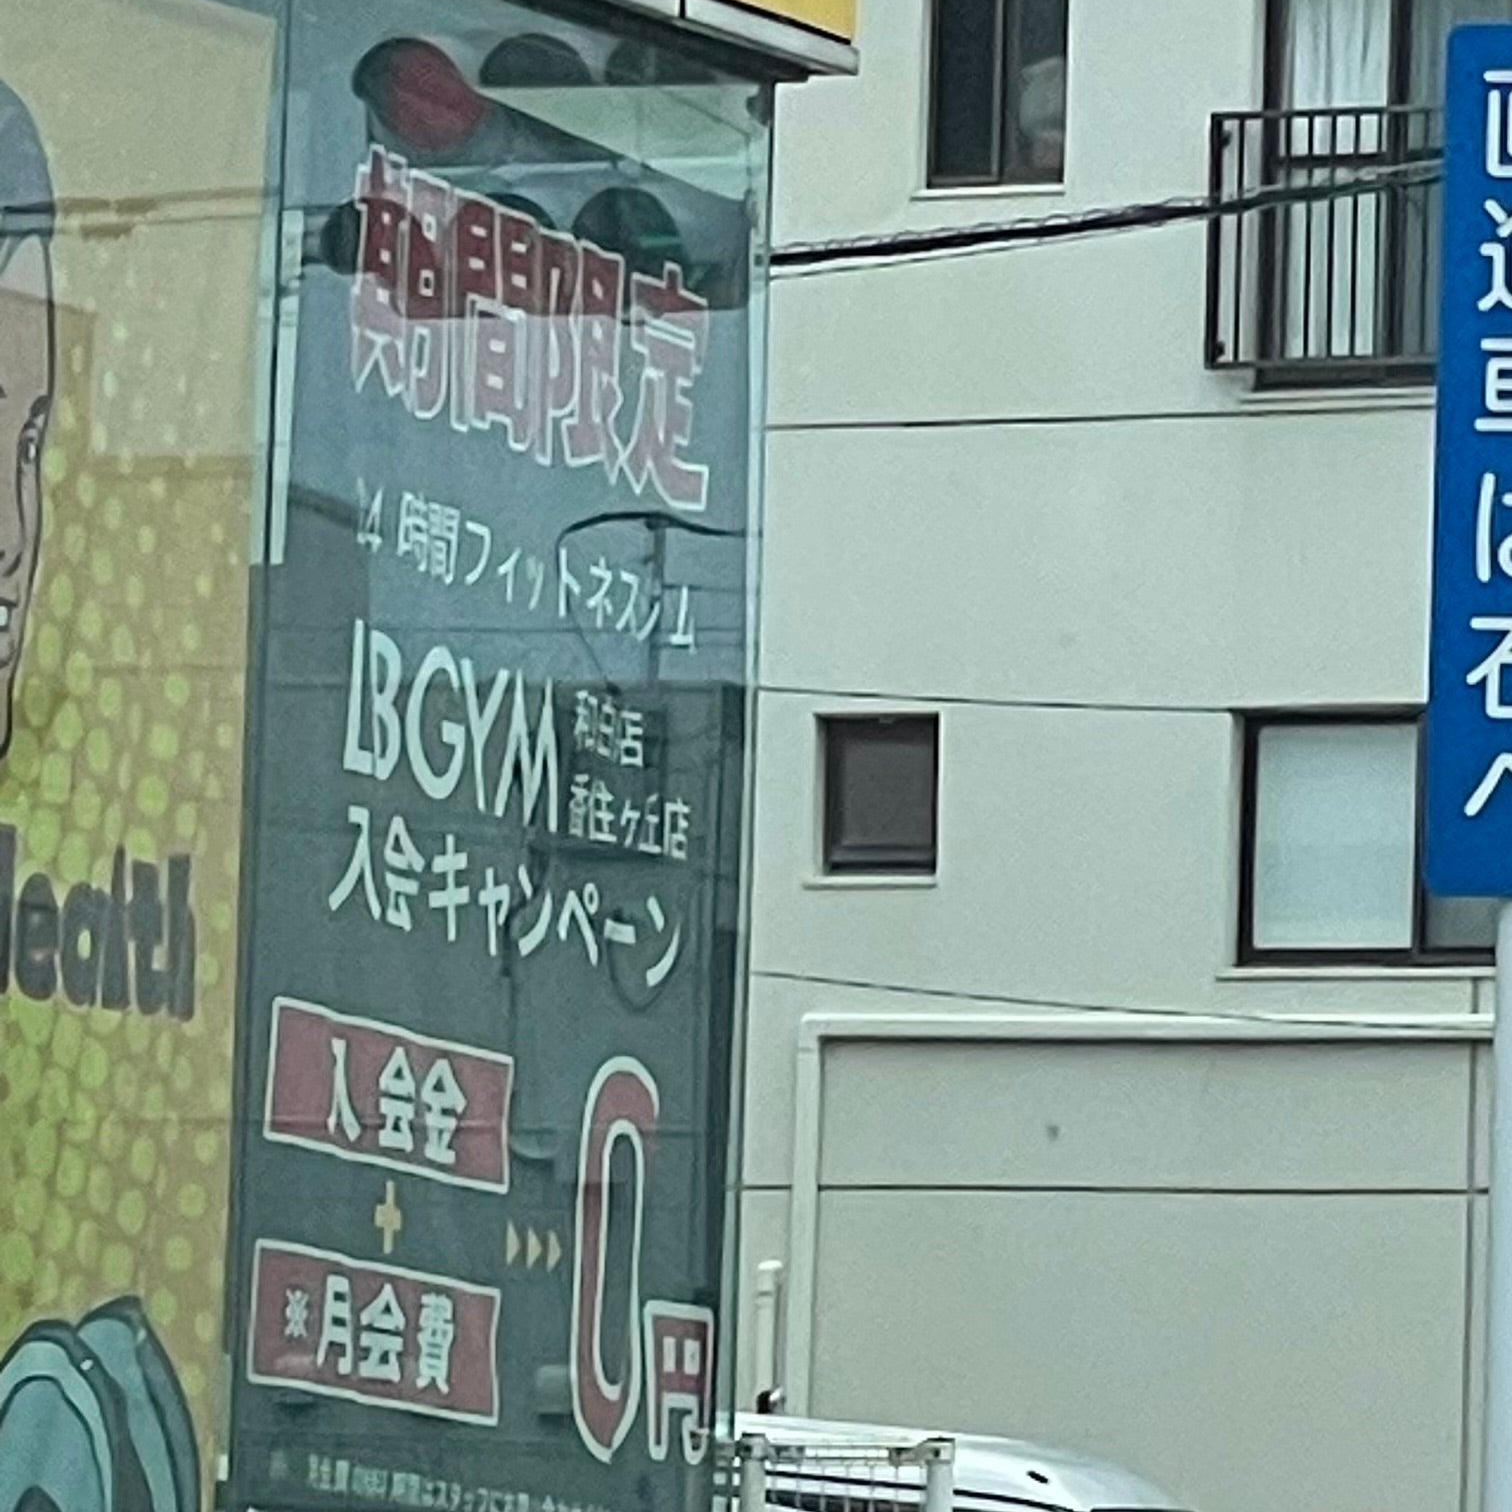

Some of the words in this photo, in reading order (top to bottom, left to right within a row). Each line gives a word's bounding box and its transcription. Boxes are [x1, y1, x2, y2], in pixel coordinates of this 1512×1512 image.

[342, 619, 558, 833] LBGYM
[329, 805, 682, 987] 入会キャンペーン
[327, 1037, 468, 1166] 入会金
